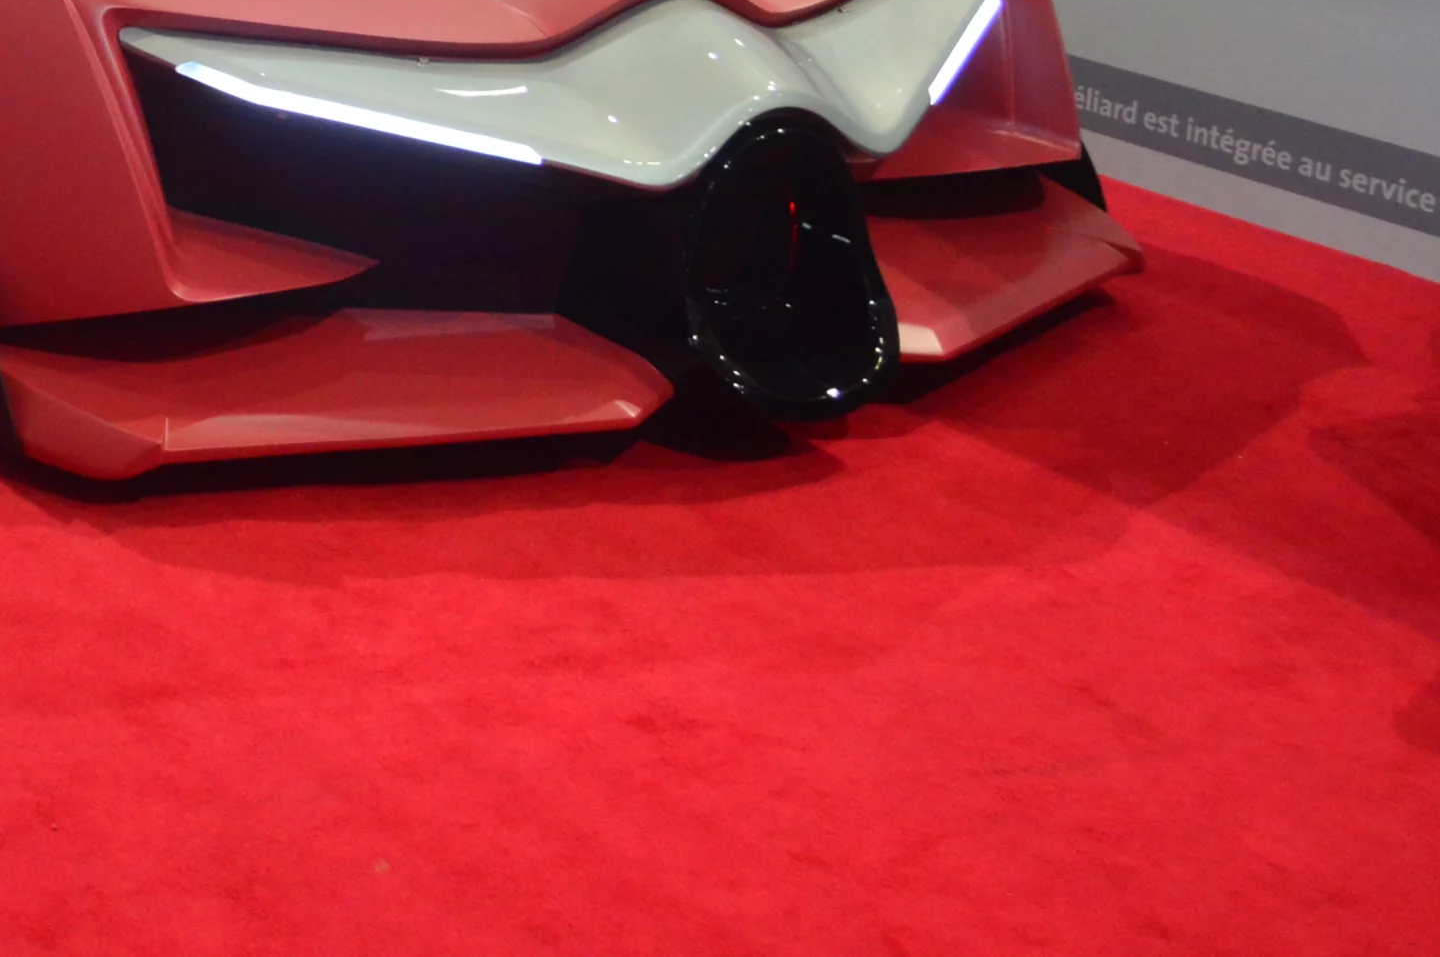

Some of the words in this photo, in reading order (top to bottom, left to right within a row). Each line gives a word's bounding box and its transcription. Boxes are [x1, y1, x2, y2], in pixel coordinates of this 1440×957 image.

[1074, 85, 1138, 125] éliard
[1143, 109, 1180, 138] est
[1186, 117, 1292, 166] intégrée
[1298, 155, 1332, 183] au
[1339, 169, 1437, 213] service
